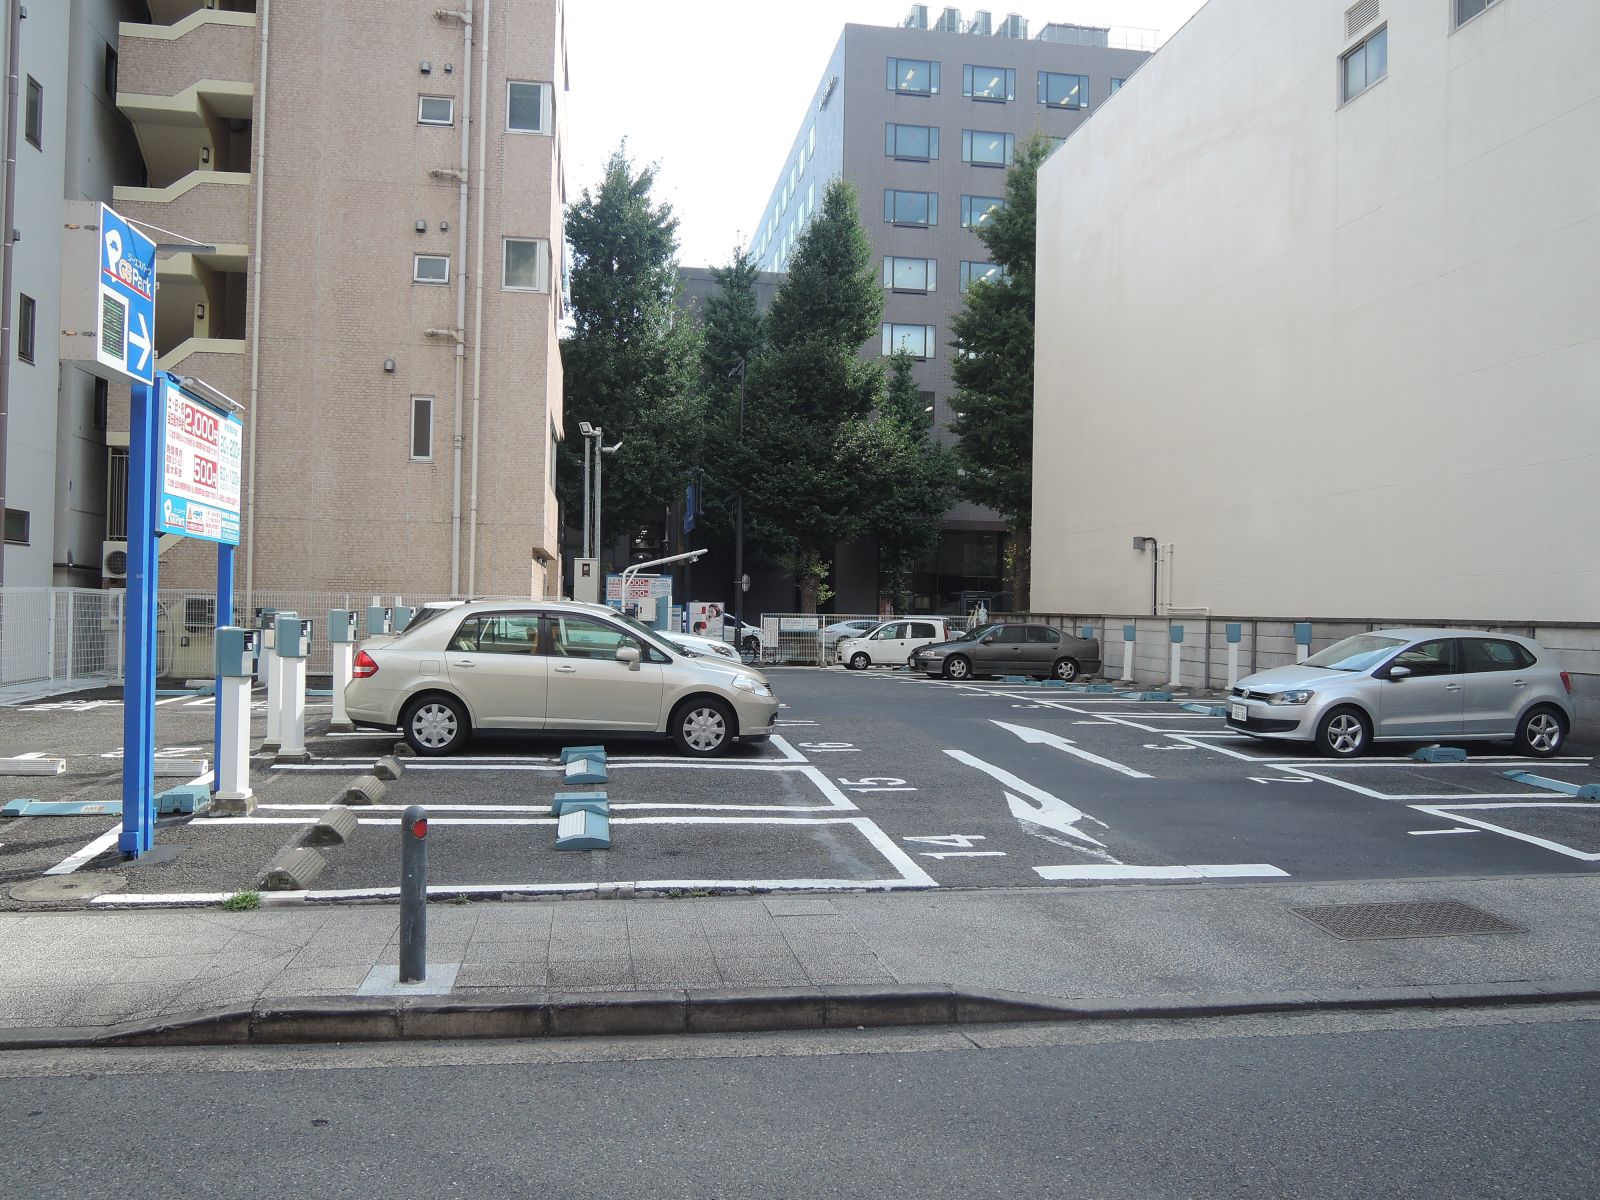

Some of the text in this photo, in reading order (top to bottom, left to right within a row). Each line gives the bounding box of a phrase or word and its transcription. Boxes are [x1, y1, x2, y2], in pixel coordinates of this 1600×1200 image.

[798, 742, 862, 752] 16
[1142, 743, 1197, 751] 3
[1245, 776, 1314, 784] 2
[837, 777, 918, 793] 15
[1407, 827, 1481, 836] 1
[902, 834, 1007, 860] 14
